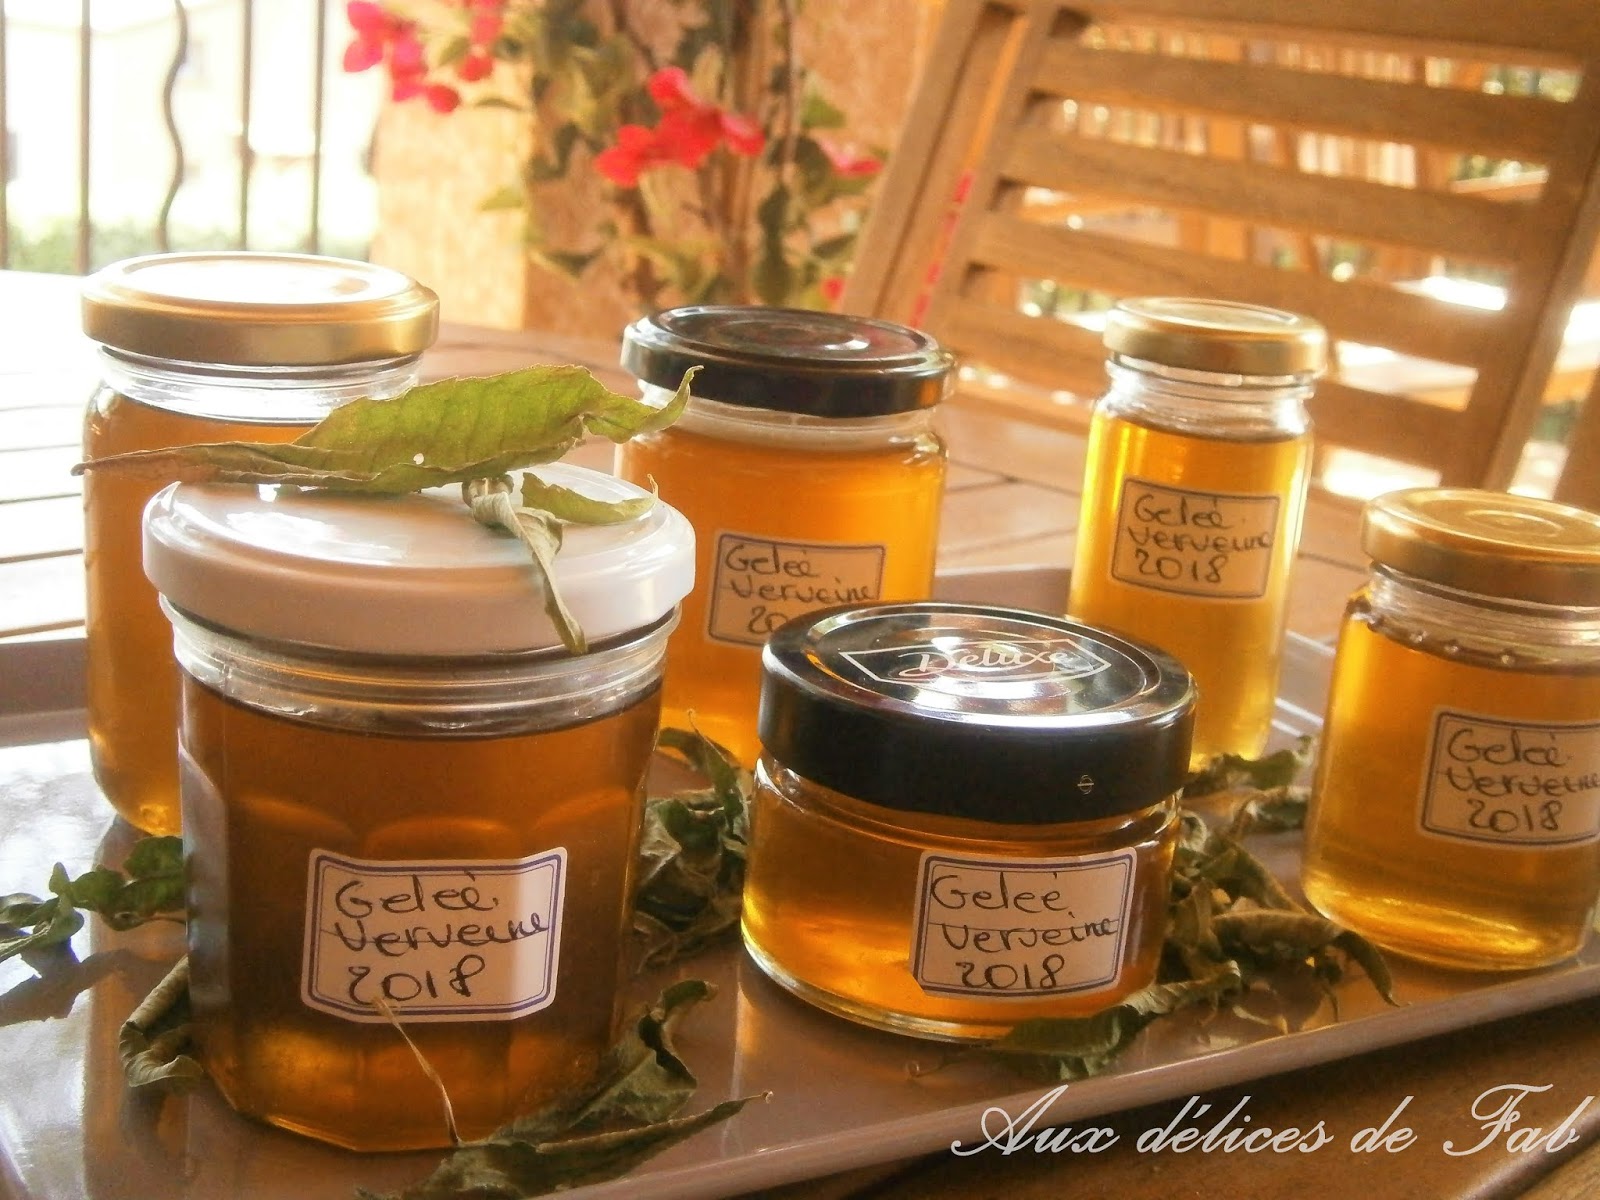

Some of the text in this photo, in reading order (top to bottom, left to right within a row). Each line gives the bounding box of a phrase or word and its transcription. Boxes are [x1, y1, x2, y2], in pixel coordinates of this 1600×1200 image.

[1135, 548, 1228, 583] 2018
[747, 605, 789, 634] 20
[896, 640, 1070, 677] Deluxe
[1467, 798, 1562, 833] 2018
[348, 954, 485, 1006] 2018
[956, 953, 1065, 990] 2018
